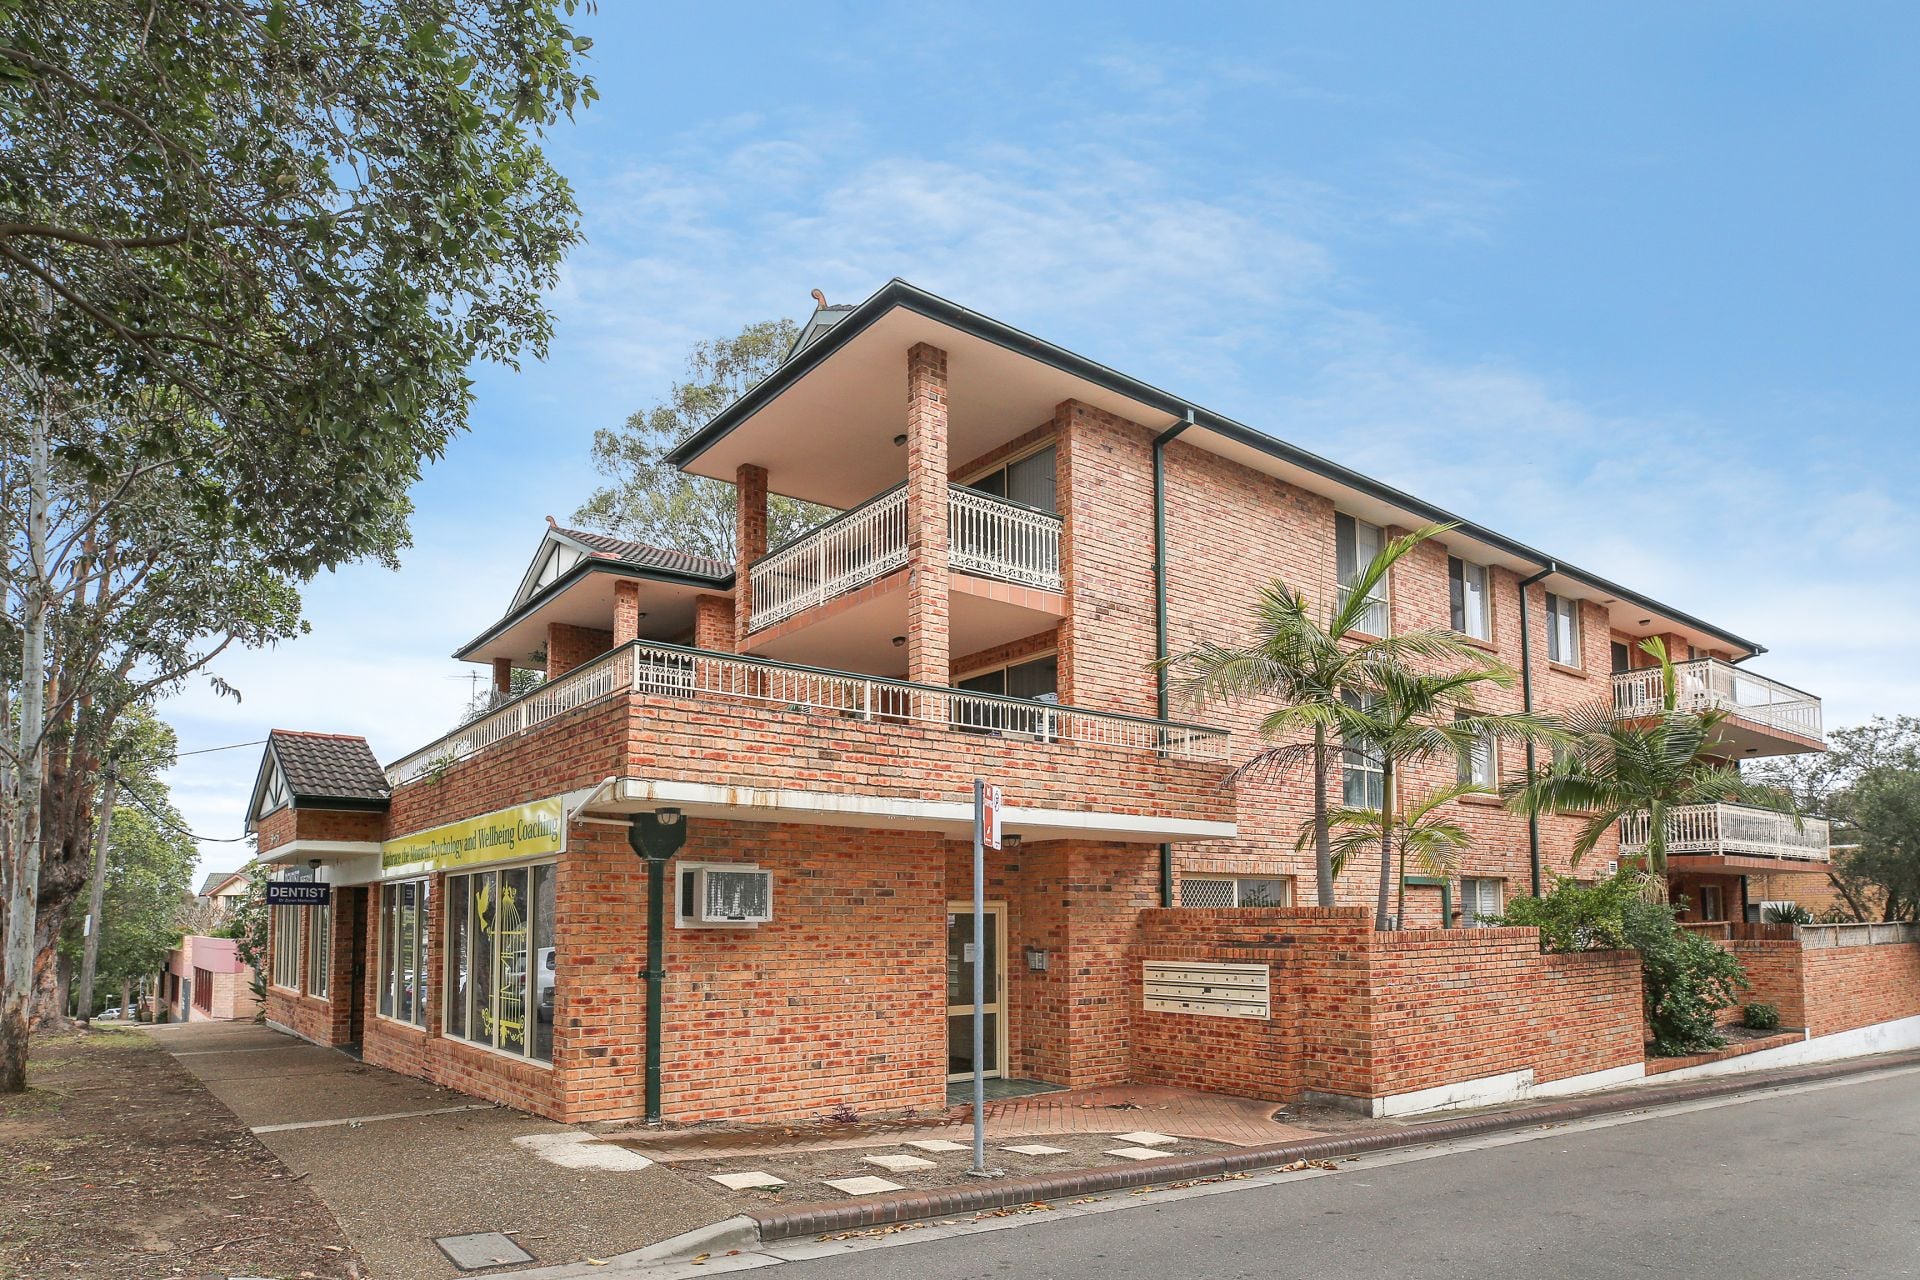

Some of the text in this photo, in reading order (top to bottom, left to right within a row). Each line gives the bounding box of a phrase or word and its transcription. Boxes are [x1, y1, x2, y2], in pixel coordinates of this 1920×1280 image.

[401, 847, 410, 863] the
[431, 839, 464, 862] Psychology
[464, 830, 477, 852] and
[478, 823, 515, 850] Wellbeing
[517, 814, 559, 843] Coaching
[270, 886, 326, 898] DENTIST
